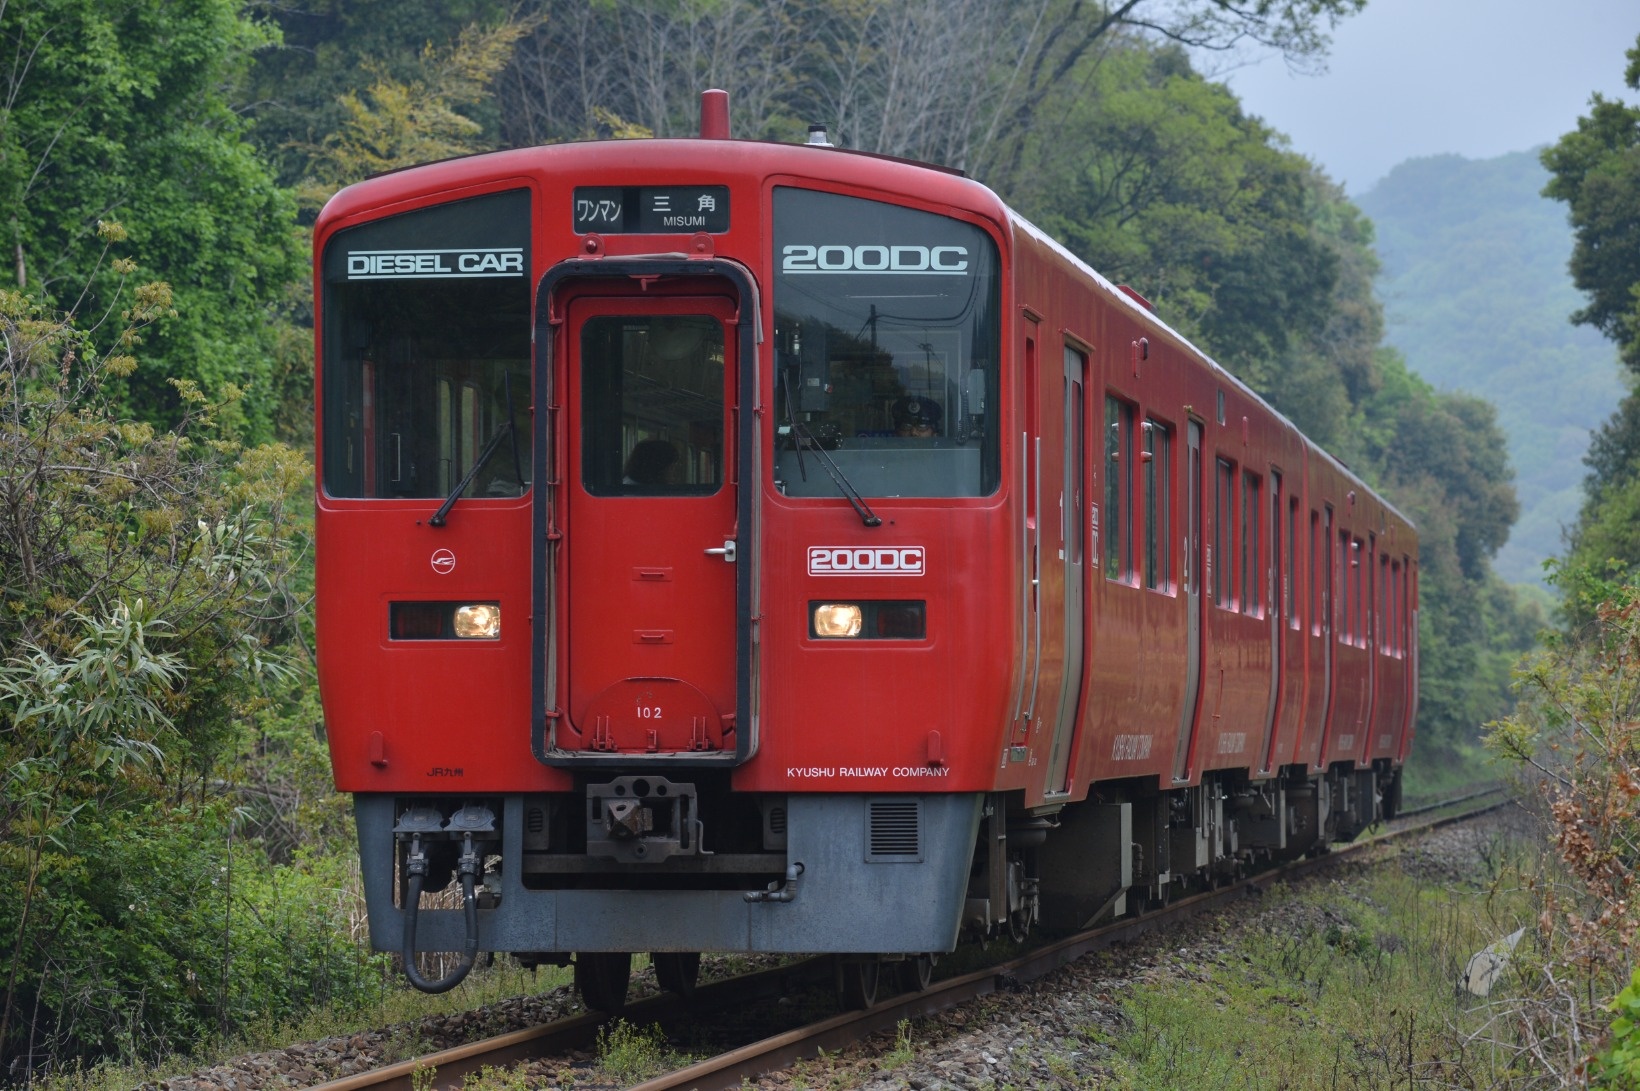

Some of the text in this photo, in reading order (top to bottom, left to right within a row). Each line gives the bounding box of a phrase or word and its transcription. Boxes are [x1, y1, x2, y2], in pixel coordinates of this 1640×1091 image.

[577, 199, 621, 222] ワンマン
[663, 216, 706, 227] MISUMI
[347, 253, 524, 275] DIESEL CAR
[782, 245, 969, 271] 200DC
[810, 549, 922, 570] 200DC
[637, 706, 662, 719] 102
[426, 767, 464, 777] JR九州
[786, 767, 950, 778] KYUSHU RAILWAY COMPANY
